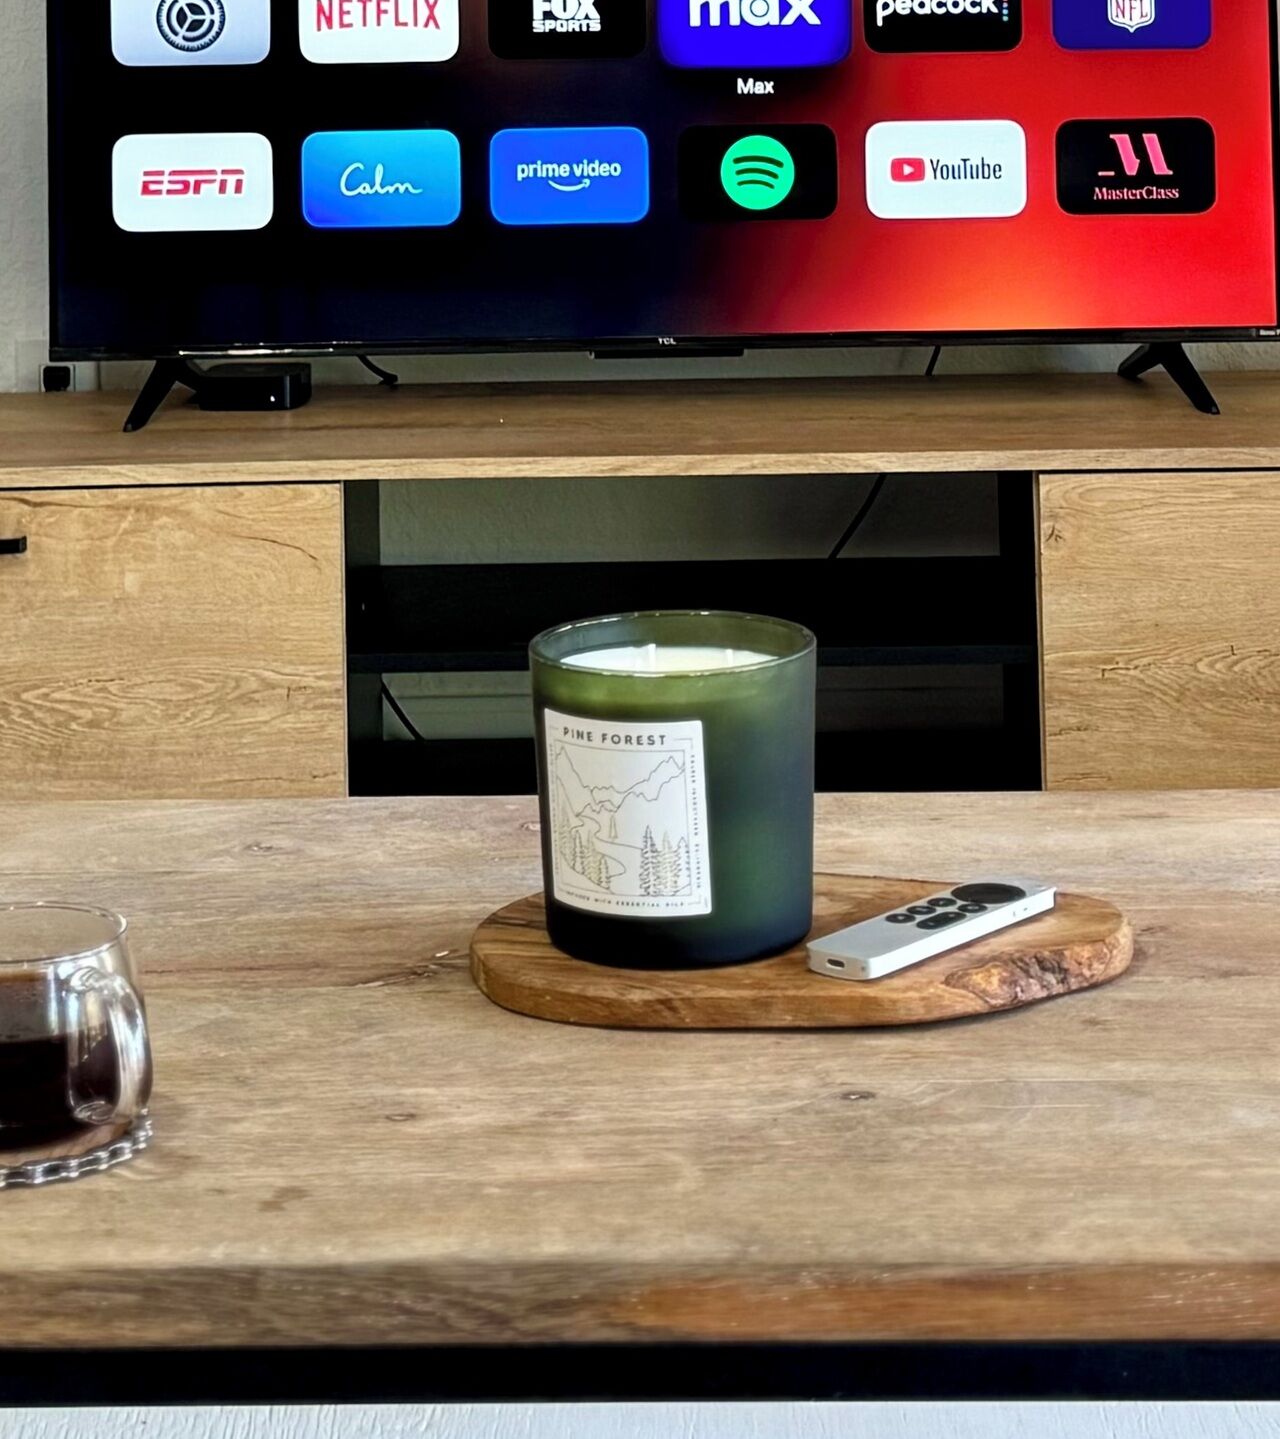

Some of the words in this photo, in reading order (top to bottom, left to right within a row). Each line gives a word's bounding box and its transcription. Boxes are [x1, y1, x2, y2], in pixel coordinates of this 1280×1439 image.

[532, 19, 602, 33] SPORTS
[737, 78, 775, 95] Max
[517, 161, 570, 181] prime
[572, 160, 622, 178] video
[930, 157, 1002, 181] YouTube
[140, 168, 246, 196] ESPN
[340, 162, 423, 197] Calm
[1093, 186, 1180, 201] MasterClass
[563, 727, 593, 742] PINE
[601, 733, 666, 746] FOREST
